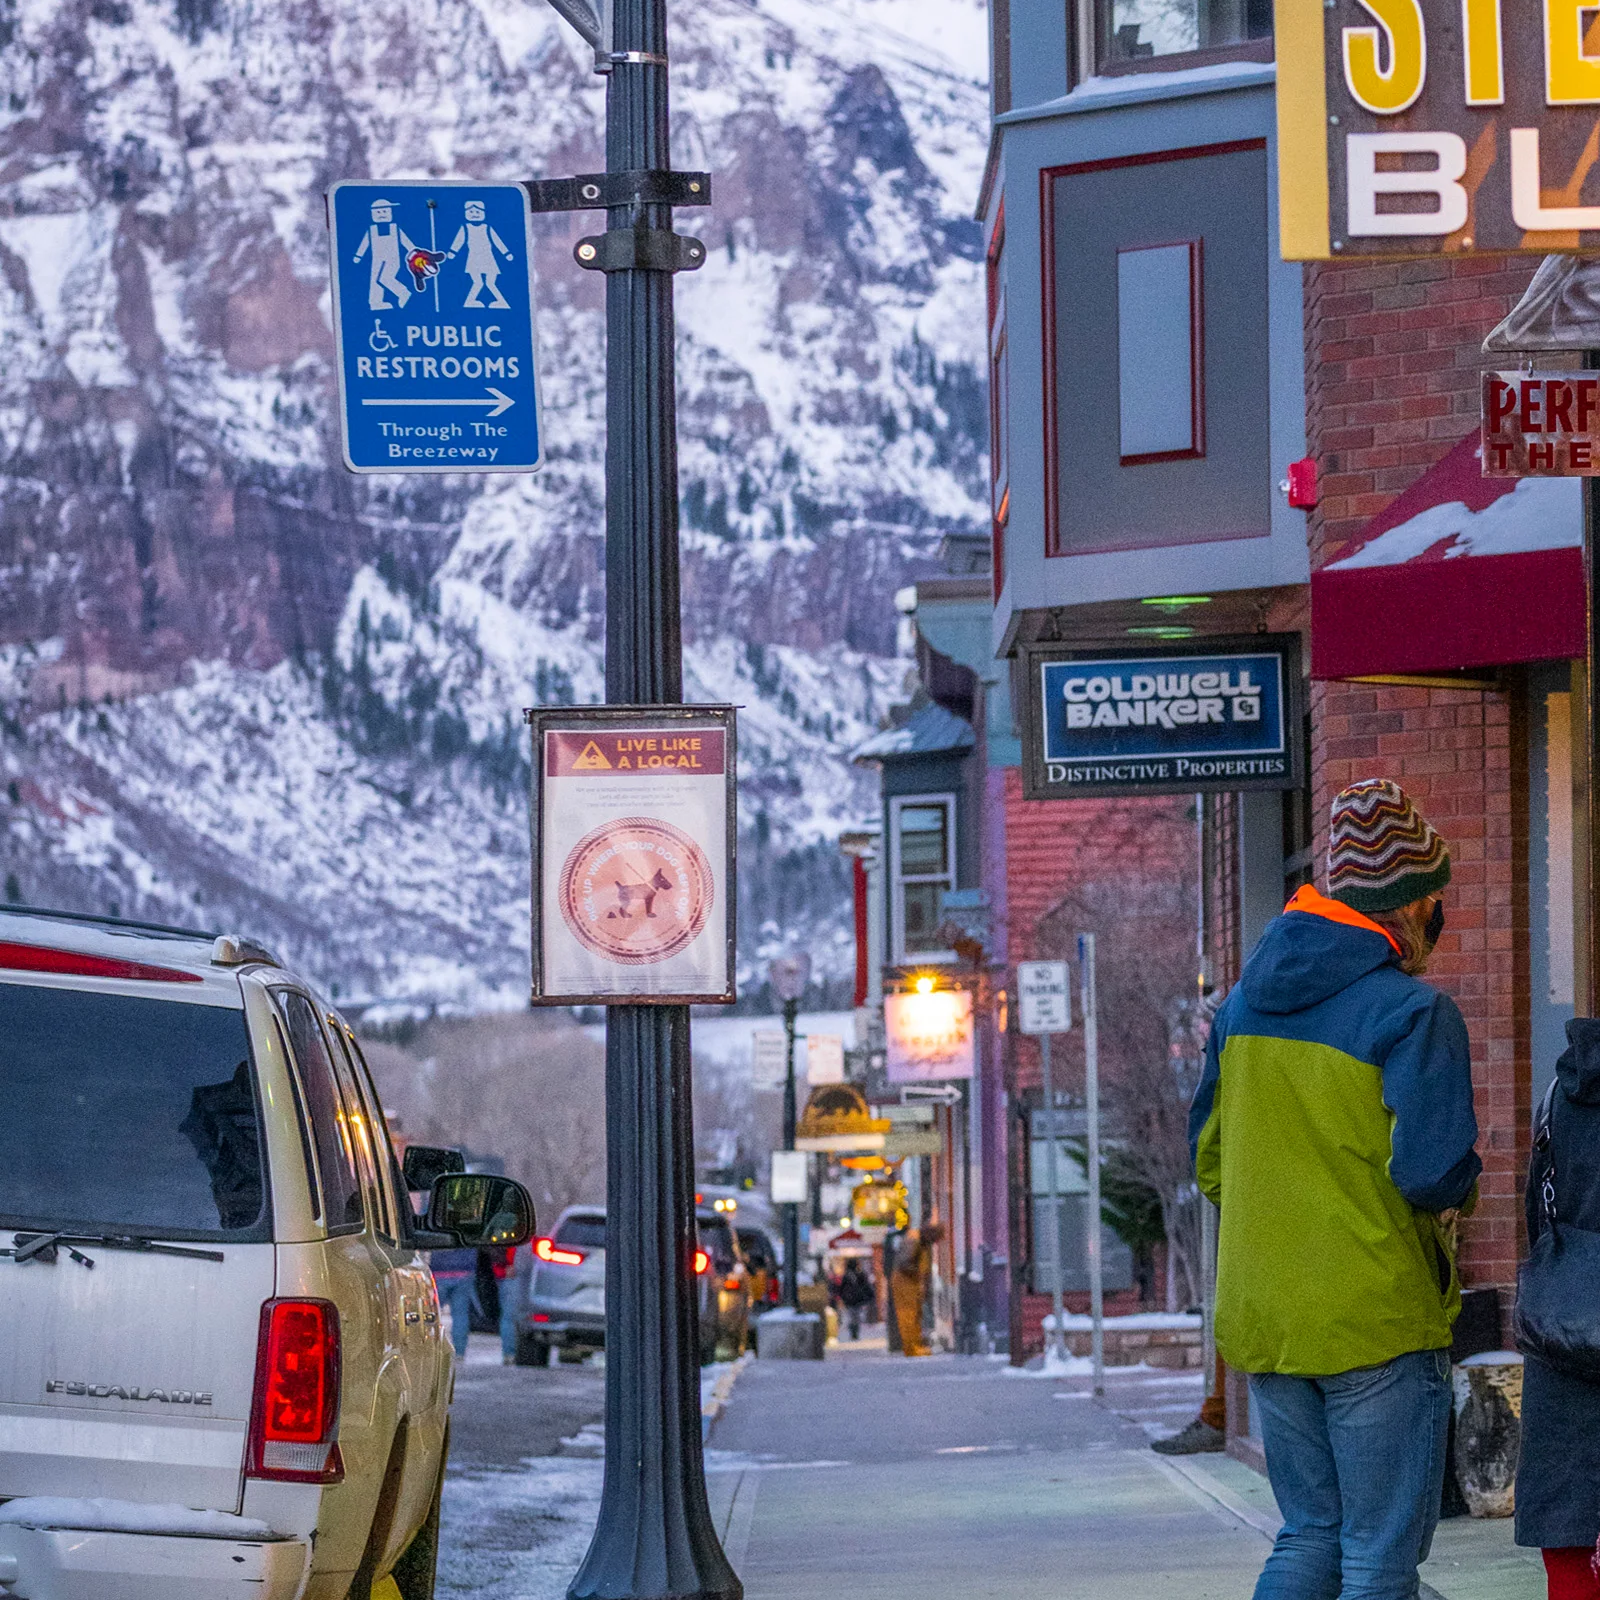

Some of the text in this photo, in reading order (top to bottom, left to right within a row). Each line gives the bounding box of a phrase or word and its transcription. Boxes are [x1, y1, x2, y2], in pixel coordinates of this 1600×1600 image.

[406, 325, 503, 347] PUBLIC
[357, 356, 520, 379] RESTROOMS
[378, 422, 508, 440] Through The
[388, 444, 499, 462] Breezeway
[616, 737, 701, 752] LIVE LIKE
[618, 754, 701, 769] A LOCAL
[588, 844, 623, 876] WHERE
[623, 840, 655, 852] YOUR
[656, 846, 679, 868] DOG
[45, 1379, 214, 1406] ESCALADE
